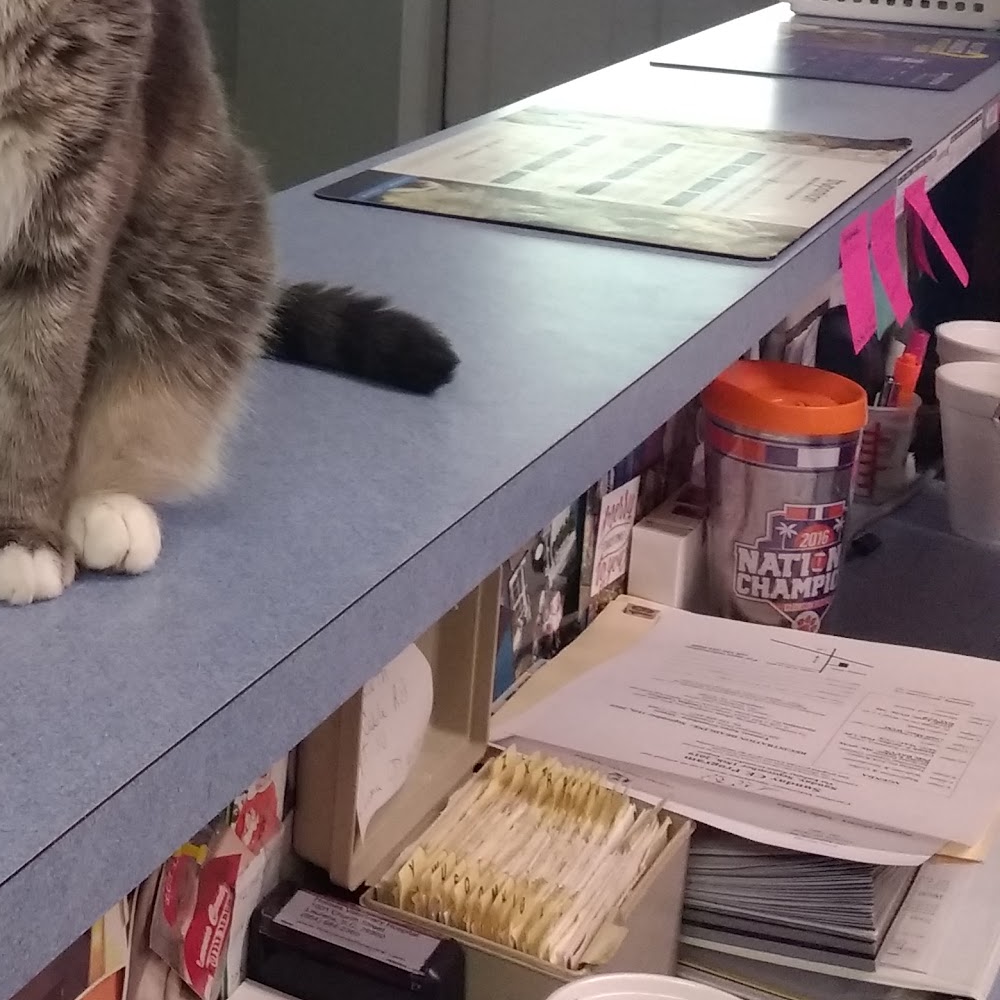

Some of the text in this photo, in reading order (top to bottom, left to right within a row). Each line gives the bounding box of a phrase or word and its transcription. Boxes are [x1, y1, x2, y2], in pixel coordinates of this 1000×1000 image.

[799, 529, 831, 548] 2016
[738, 544, 839, 578] NATION
[736, 570, 839, 599] CHAMPIO
